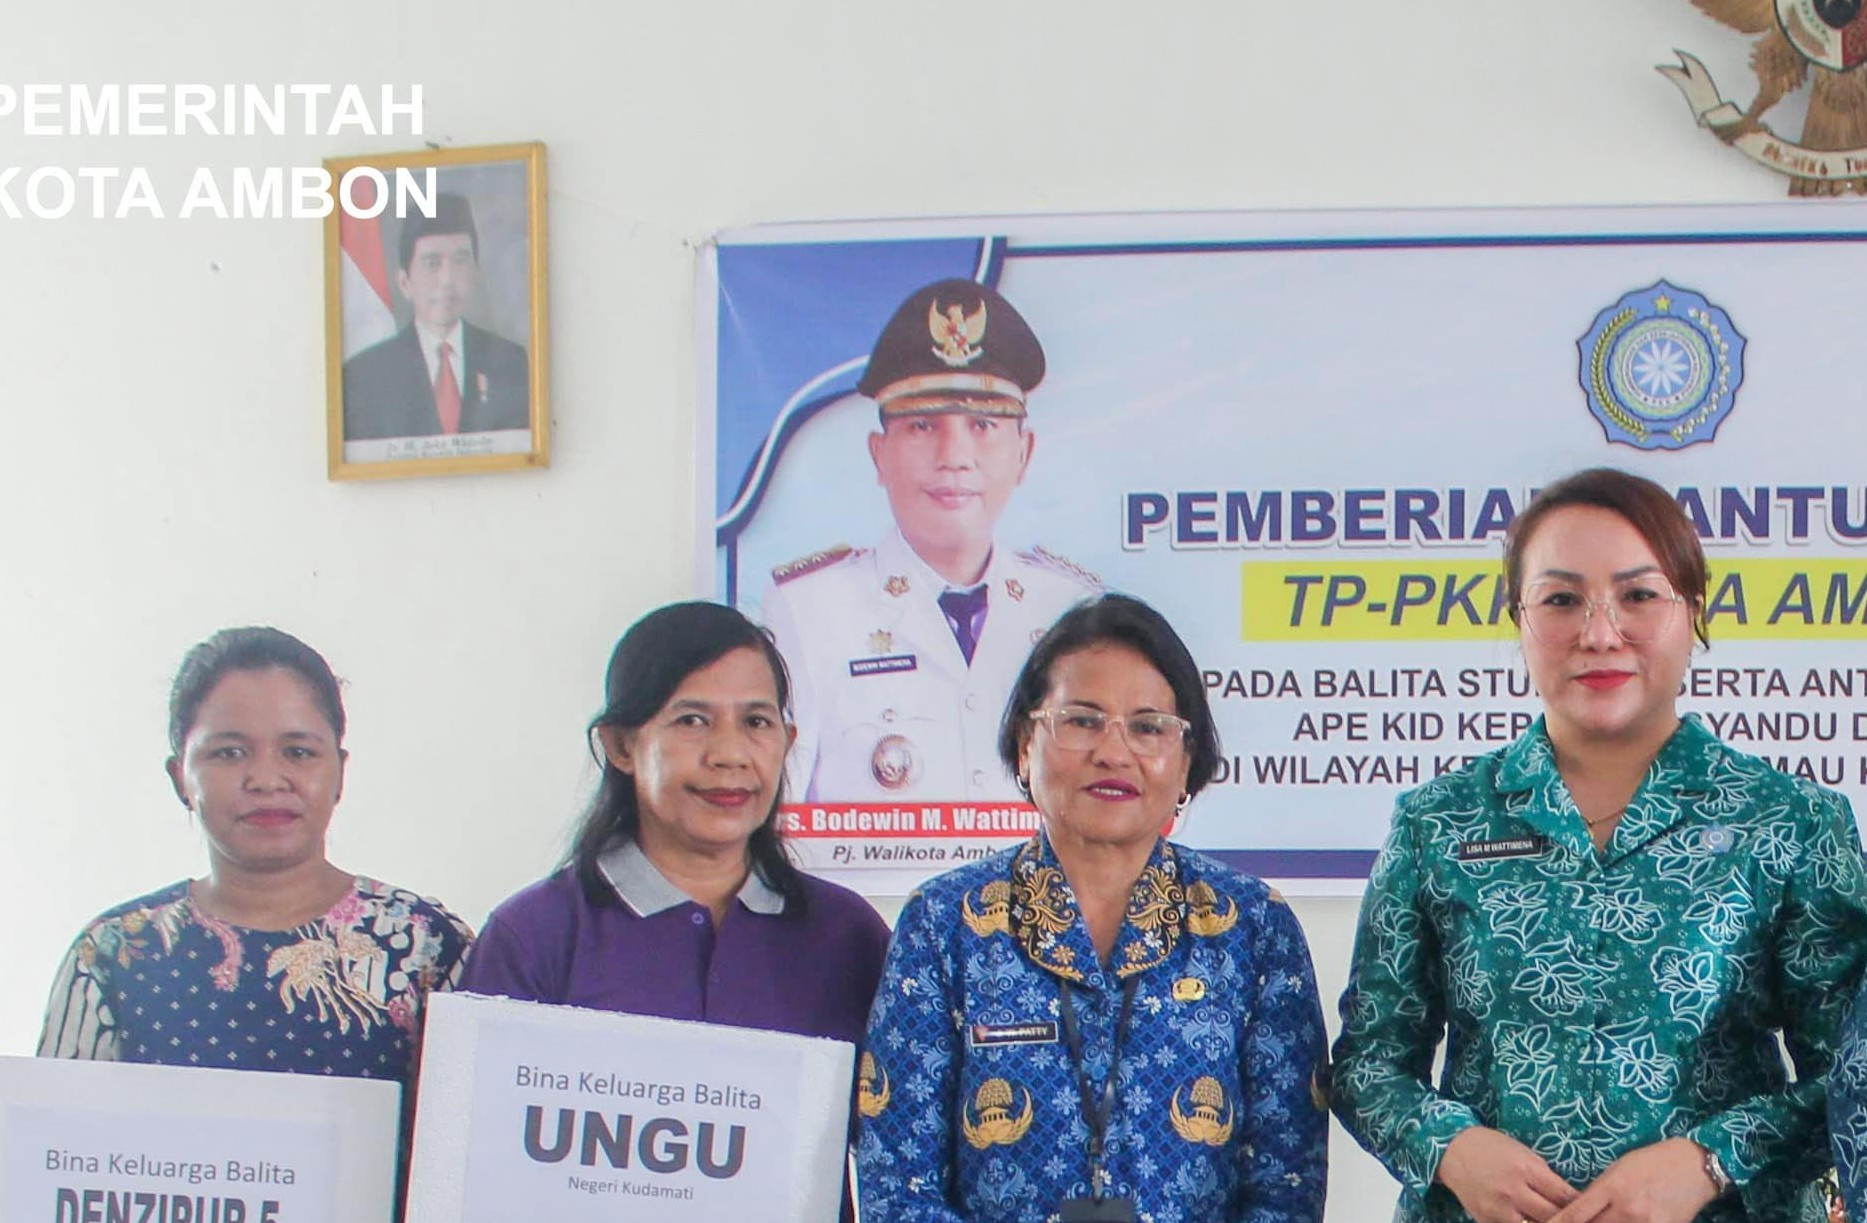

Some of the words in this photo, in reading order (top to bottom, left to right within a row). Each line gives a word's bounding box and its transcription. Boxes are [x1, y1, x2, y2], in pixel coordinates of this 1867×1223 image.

[1125, 486, 1544, 547] PEMBERIA
[1203, 669, 1302, 698] PADA
[1313, 669, 1447, 698] BALITA
[1292, 712, 1369, 742] APE
[1382, 712, 1444, 742] KID
[1253, 756, 1419, 784] WILAYAH
[811, 807, 915, 832] Bodewin
[921, 808, 947, 831] M.
[953, 808, 1041, 832] Wattim
[832, 846, 855, 862] Pj.
[860, 845, 946, 861] Walikota
[953, 845, 995, 861] Amb
[515, 1064, 570, 1091] Bina
[578, 1070, 686, 1107] Keluarga
[694, 1082, 762, 1111] Balita
[522, 1104, 747, 1180] UNGU
[45, 1149, 100, 1173] Bina
[108, 1153, 217, 1184] Keluarga
[226, 1160, 296, 1185] Balita
[567, 1176, 619, 1196] Negeri
[622, 1180, 695, 1201] Kudamati
